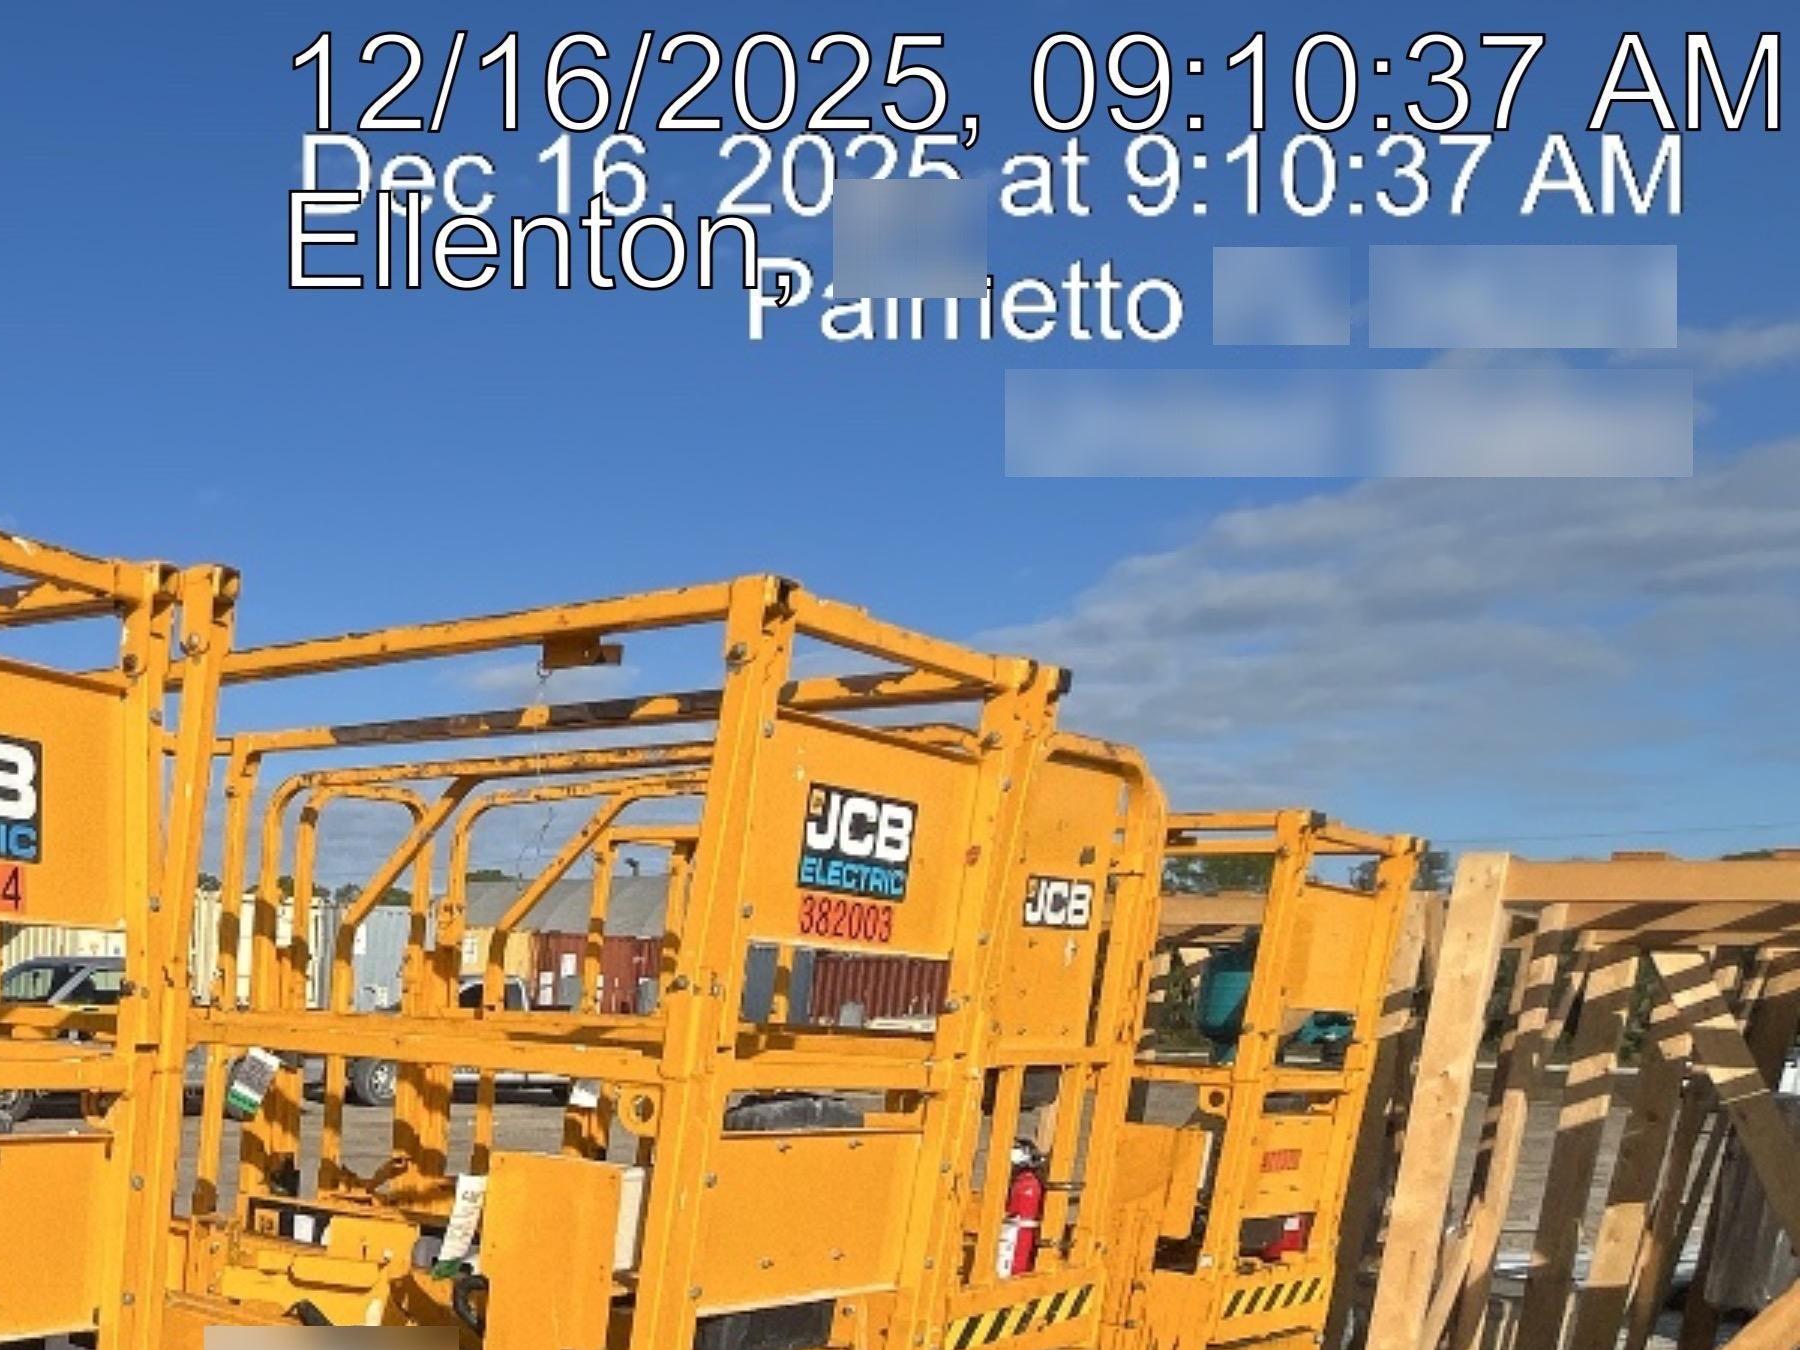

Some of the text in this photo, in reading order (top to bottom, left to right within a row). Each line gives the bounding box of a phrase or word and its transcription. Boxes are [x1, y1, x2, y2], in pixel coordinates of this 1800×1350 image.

[806, 790, 913, 862] JCB
[801, 855, 906, 896] ELECTRIC
[800, 894, 893, 943] 382003
[1025, 879, 1093, 925] JCB
